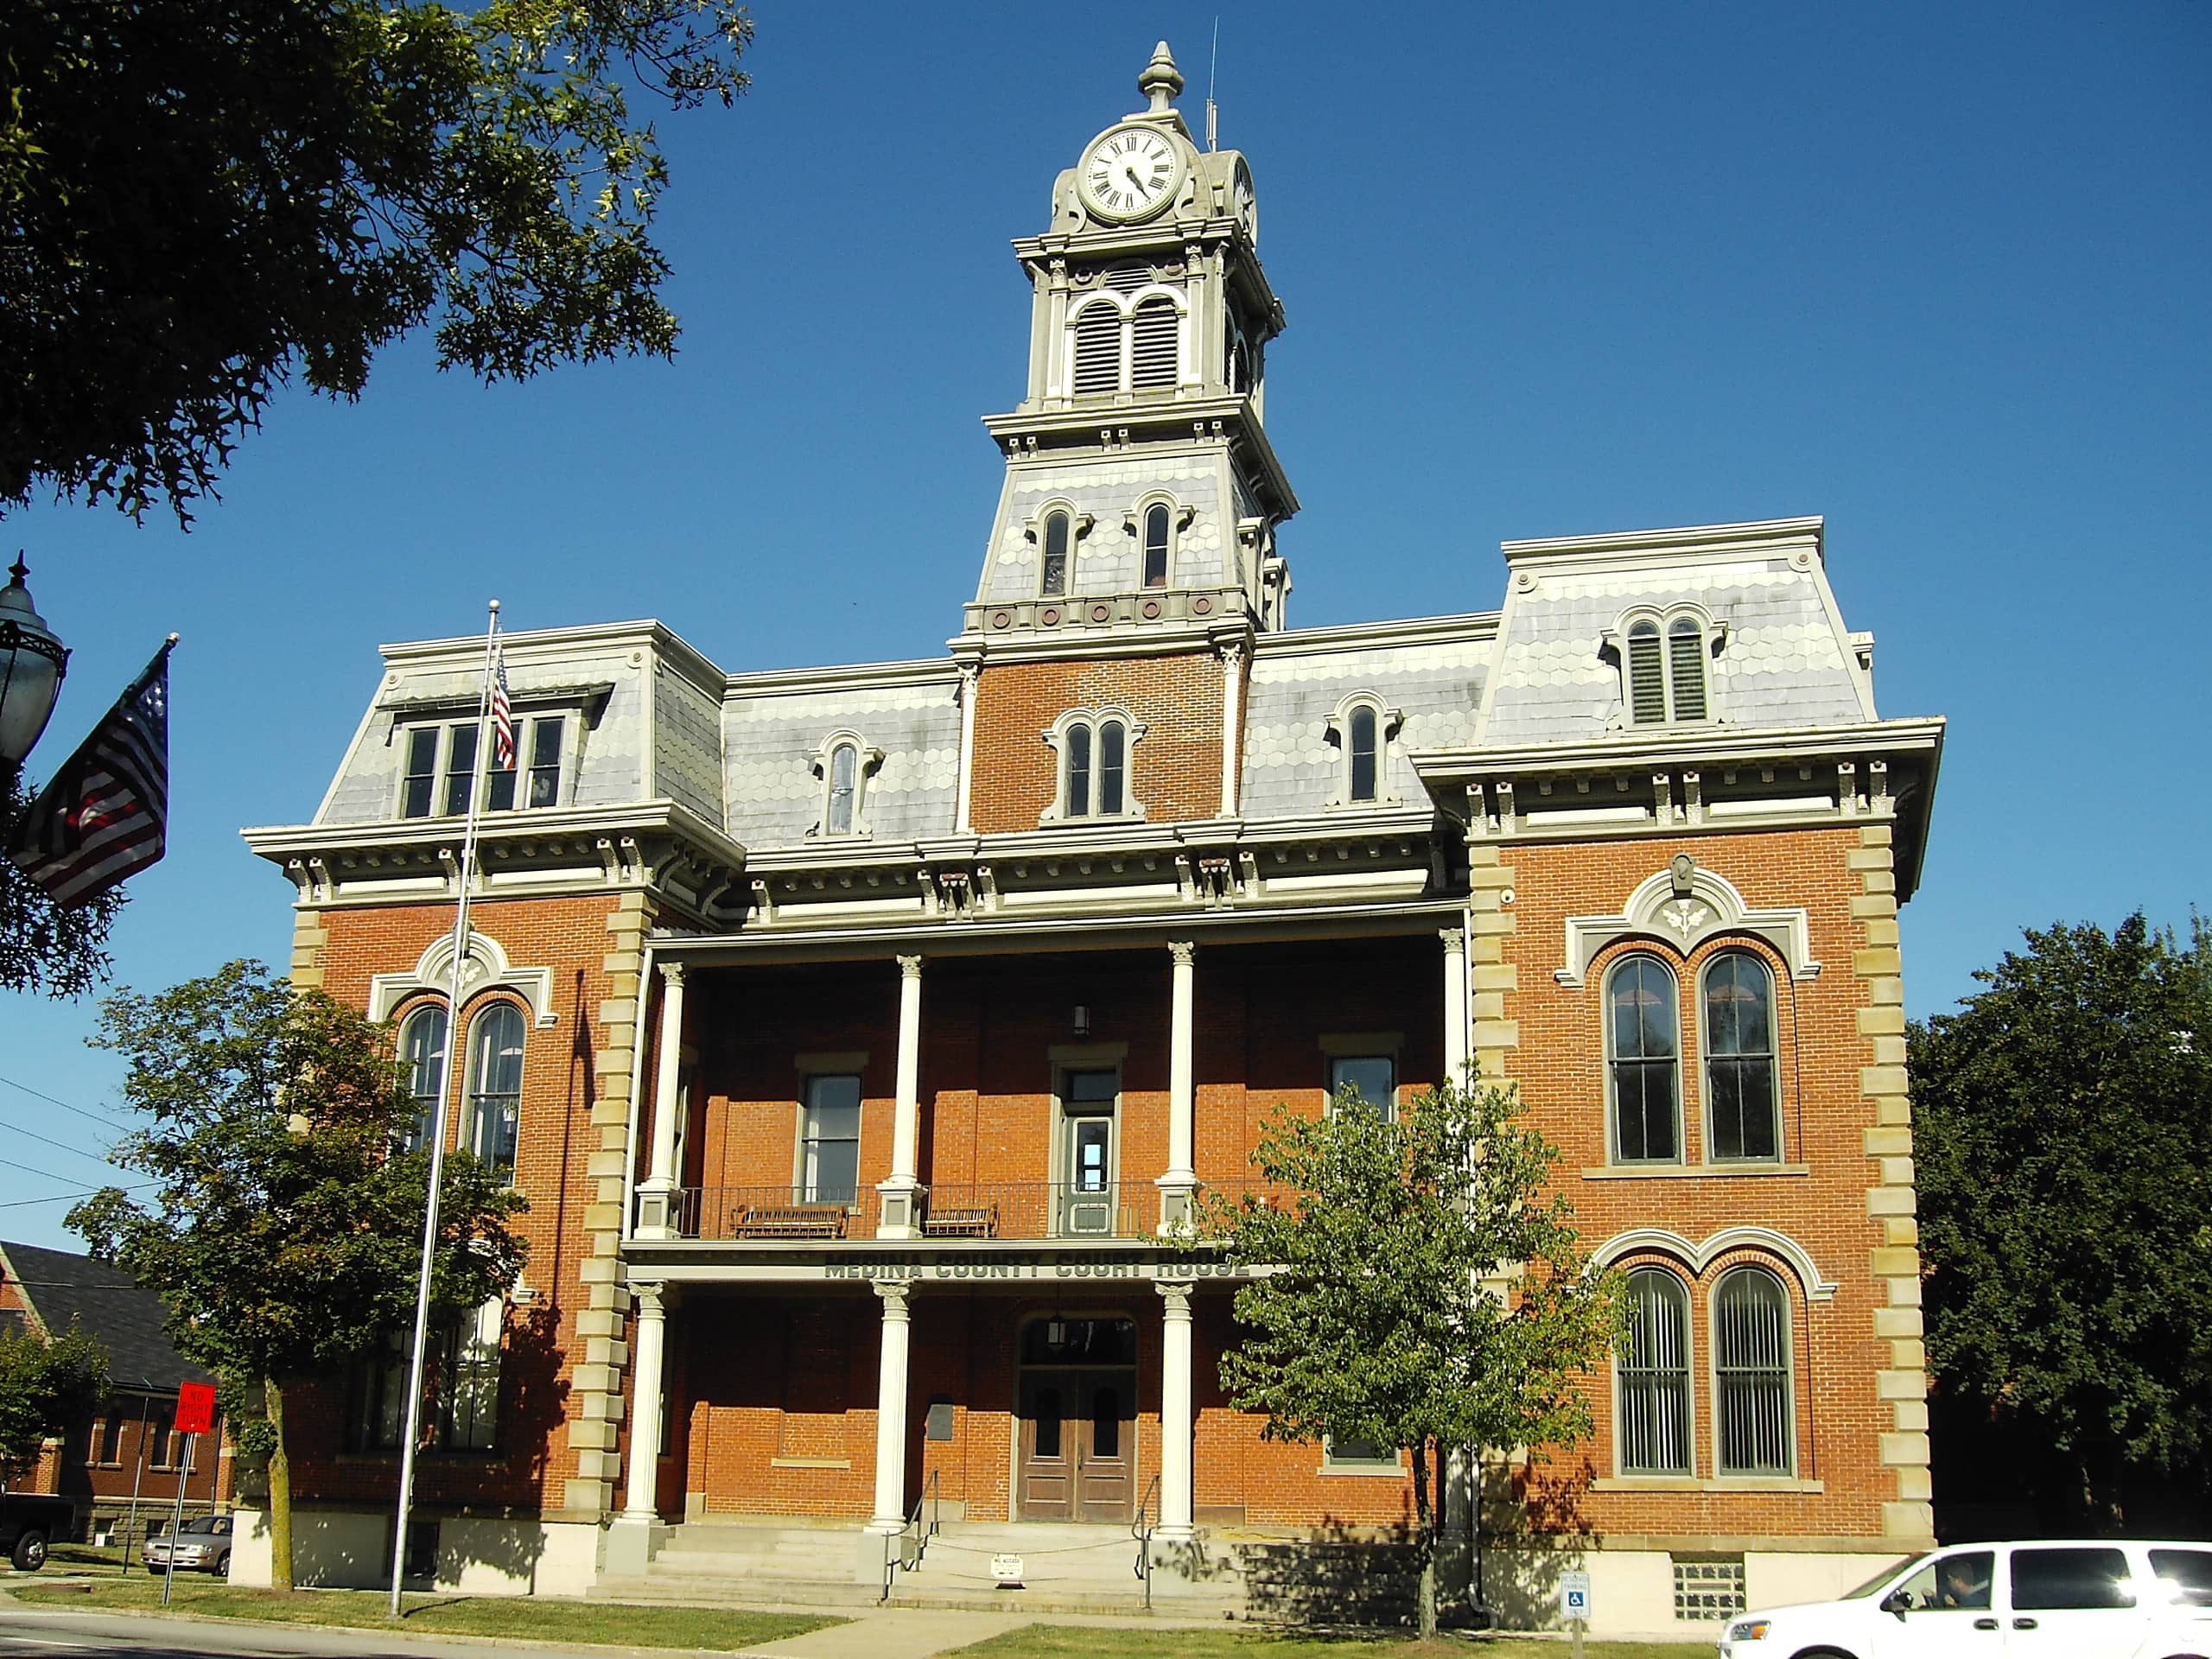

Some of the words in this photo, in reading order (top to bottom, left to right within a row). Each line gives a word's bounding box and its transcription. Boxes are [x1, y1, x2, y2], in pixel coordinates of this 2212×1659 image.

[825, 1255, 923, 1278] MEDINA
[936, 1255, 1040, 1278] COUNTY
[1056, 1255, 1142, 1277] COURT
[1157, 1255, 1250, 1277] HOUSE
[190, 1390, 204, 1402] NO
[181, 1402, 208, 1413] RIGHT
[181, 1414, 207, 1426] TURN
